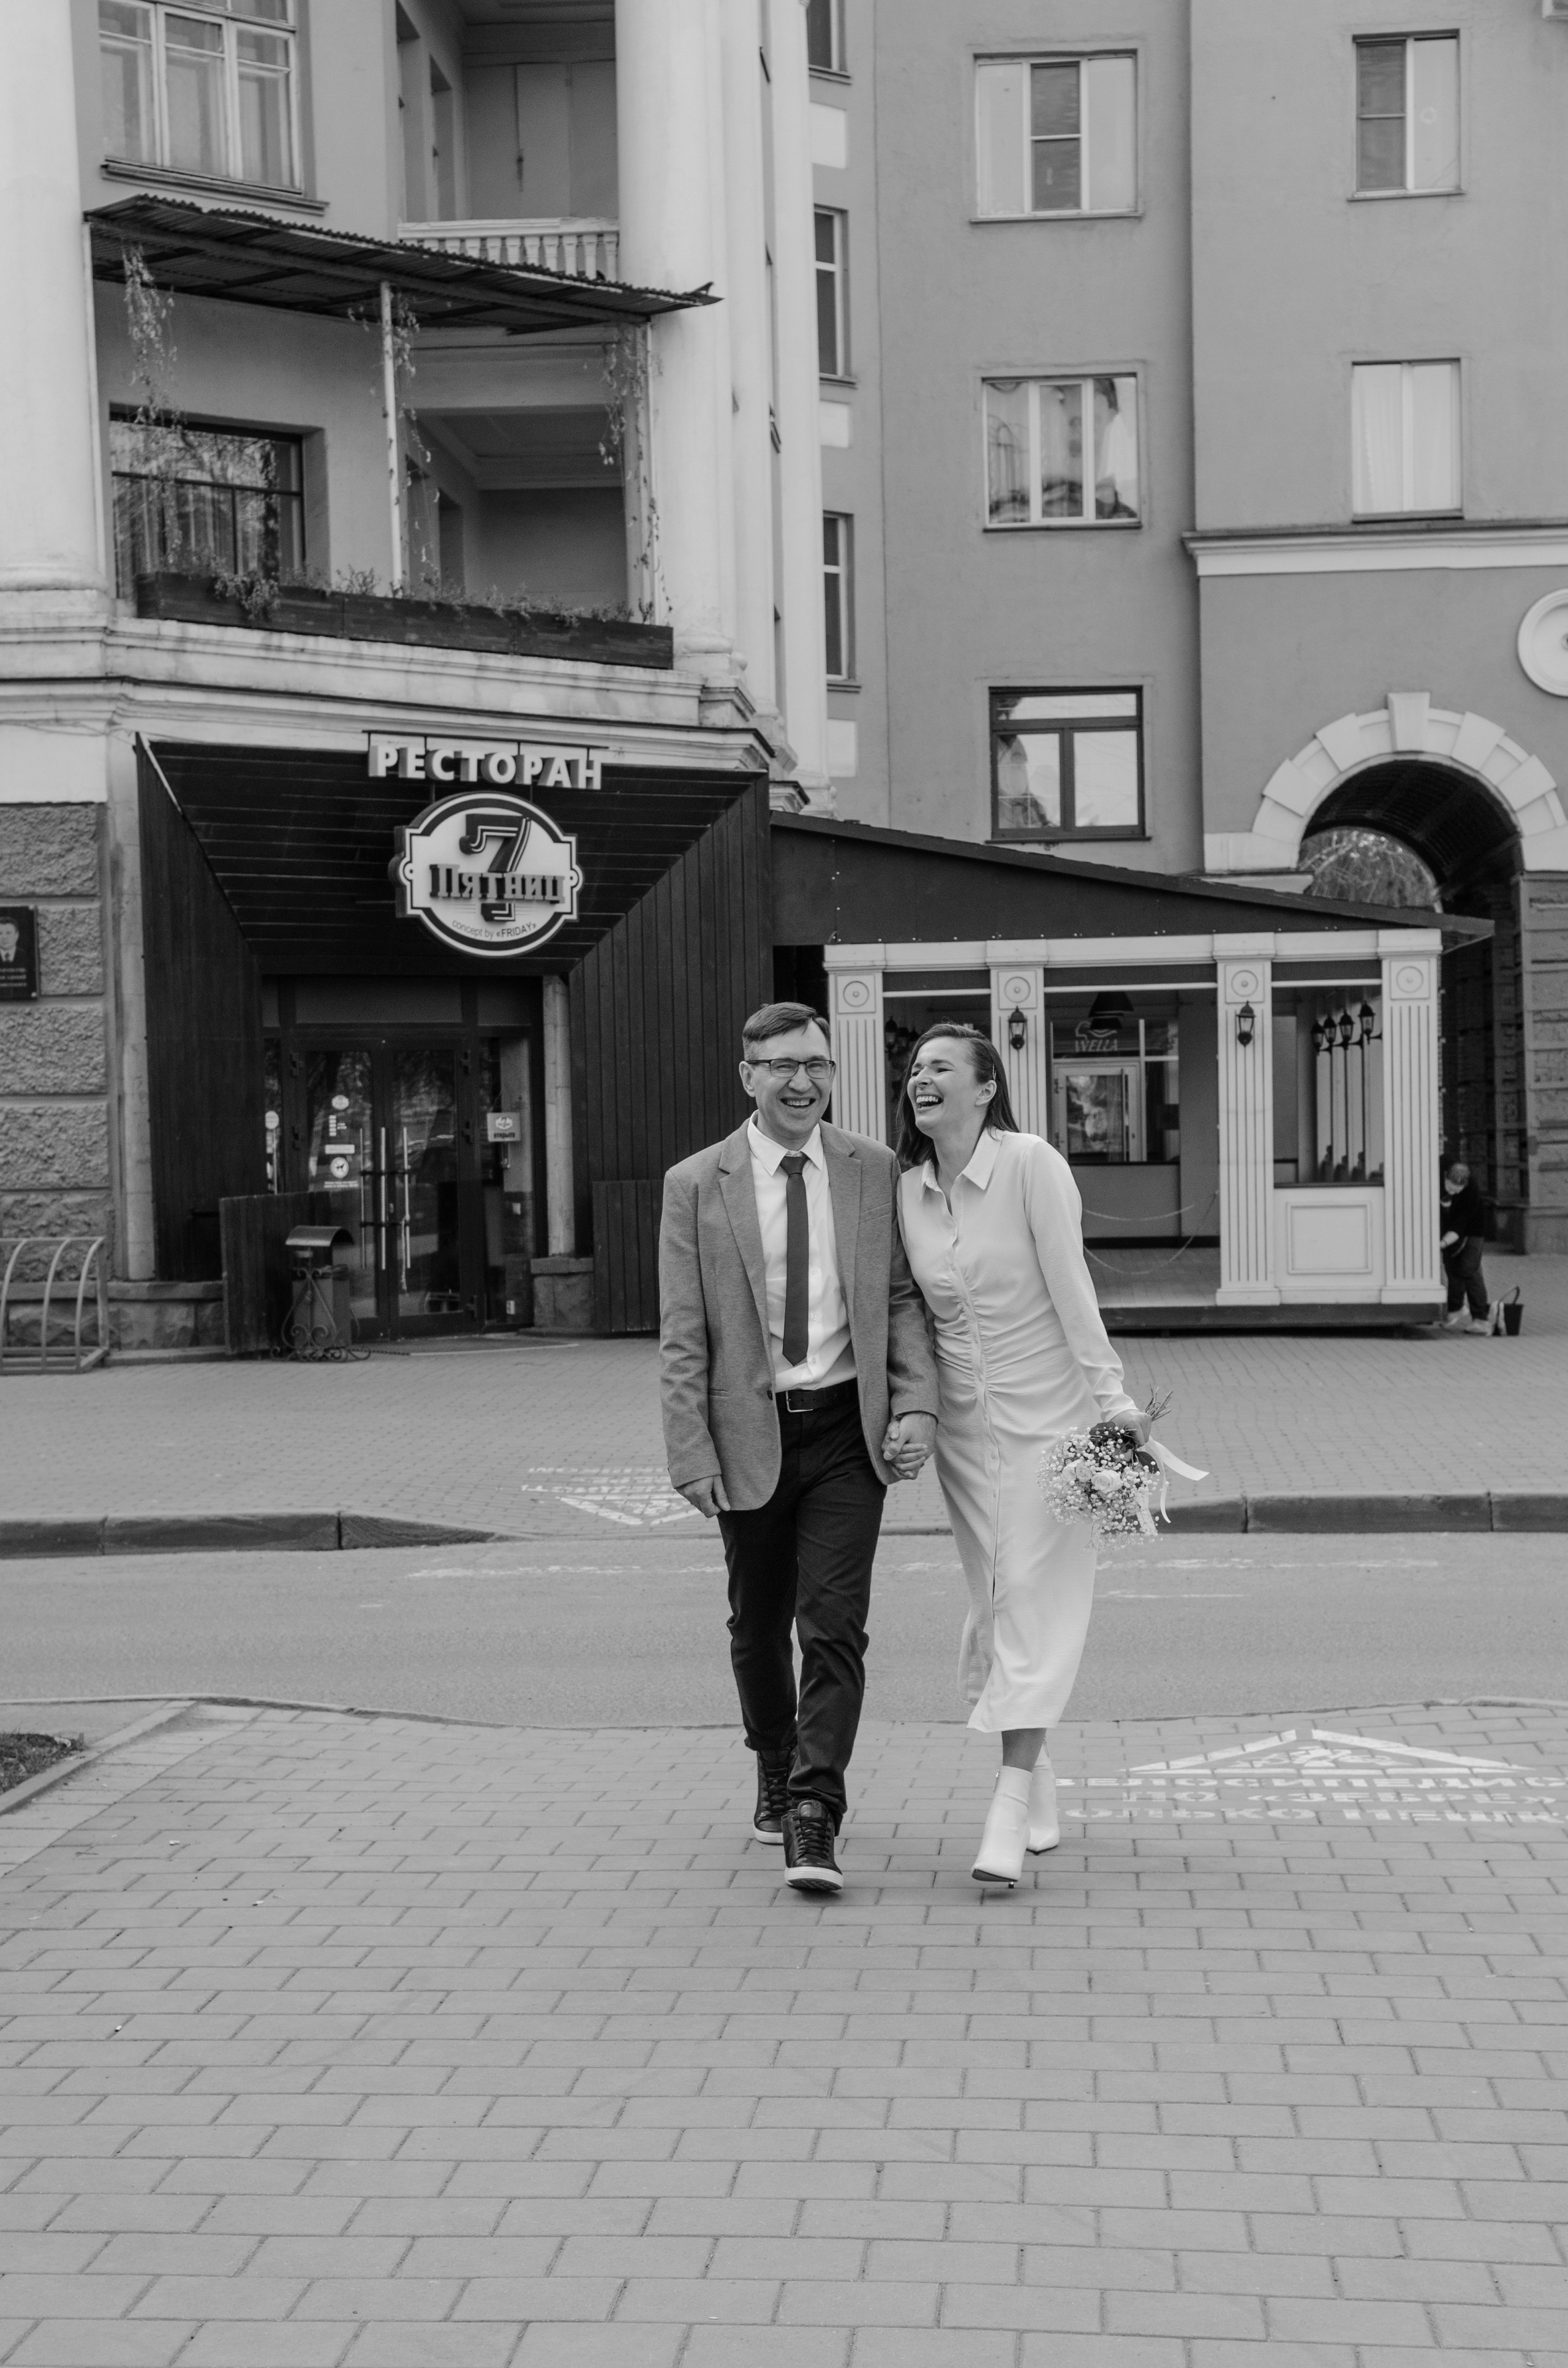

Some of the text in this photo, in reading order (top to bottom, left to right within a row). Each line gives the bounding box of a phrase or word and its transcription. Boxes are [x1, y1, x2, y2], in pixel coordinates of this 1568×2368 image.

[369, 744, 602, 790] РЕСТОРАН
[459, 814, 532, 921] 7
[430, 864, 565, 904] Пятниц
[452, 920, 537, 940] concept by «FRIDAY»
[1055, 1777, 1568, 1788] ВЕЛОСИПЕДИС
[1123, 1791, 1556, 1804] ПО «ЗЕБРЕ»
[1057, 1807, 1568, 1823] ОЛЬКО ПЕШК
